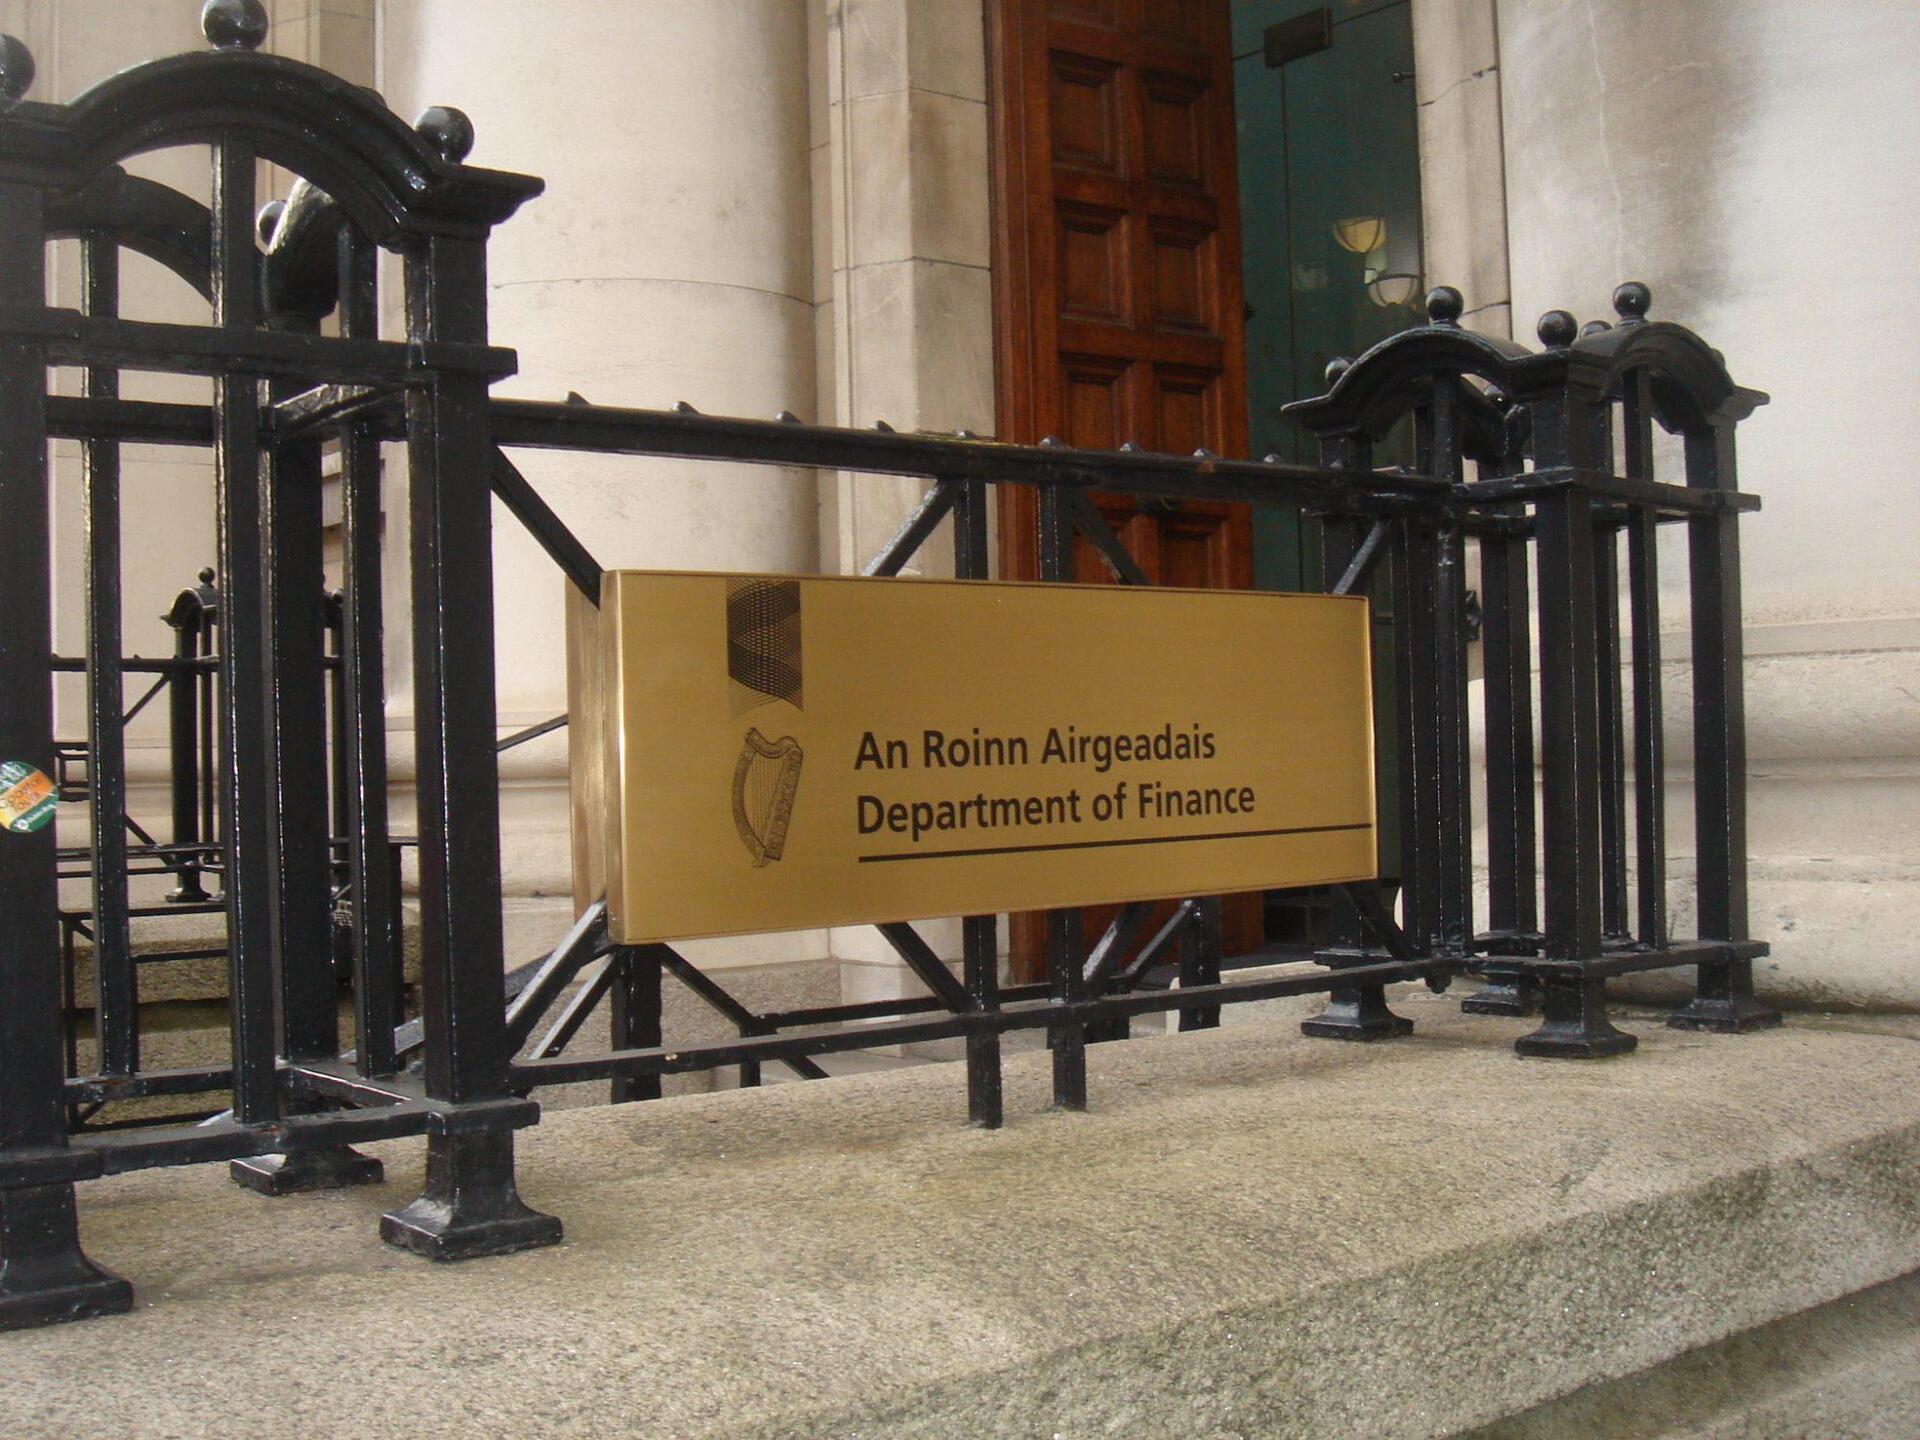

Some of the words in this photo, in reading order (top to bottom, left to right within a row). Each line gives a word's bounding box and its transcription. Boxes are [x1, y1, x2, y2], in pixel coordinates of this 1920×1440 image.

[854, 731, 909, 771] An
[923, 726, 1029, 769] Roinn
[1040, 722, 1217, 774] Airgeadais
[857, 788, 1082, 843] Department
[1091, 781, 1128, 822] of
[1138, 780, 1256, 819] Finance
